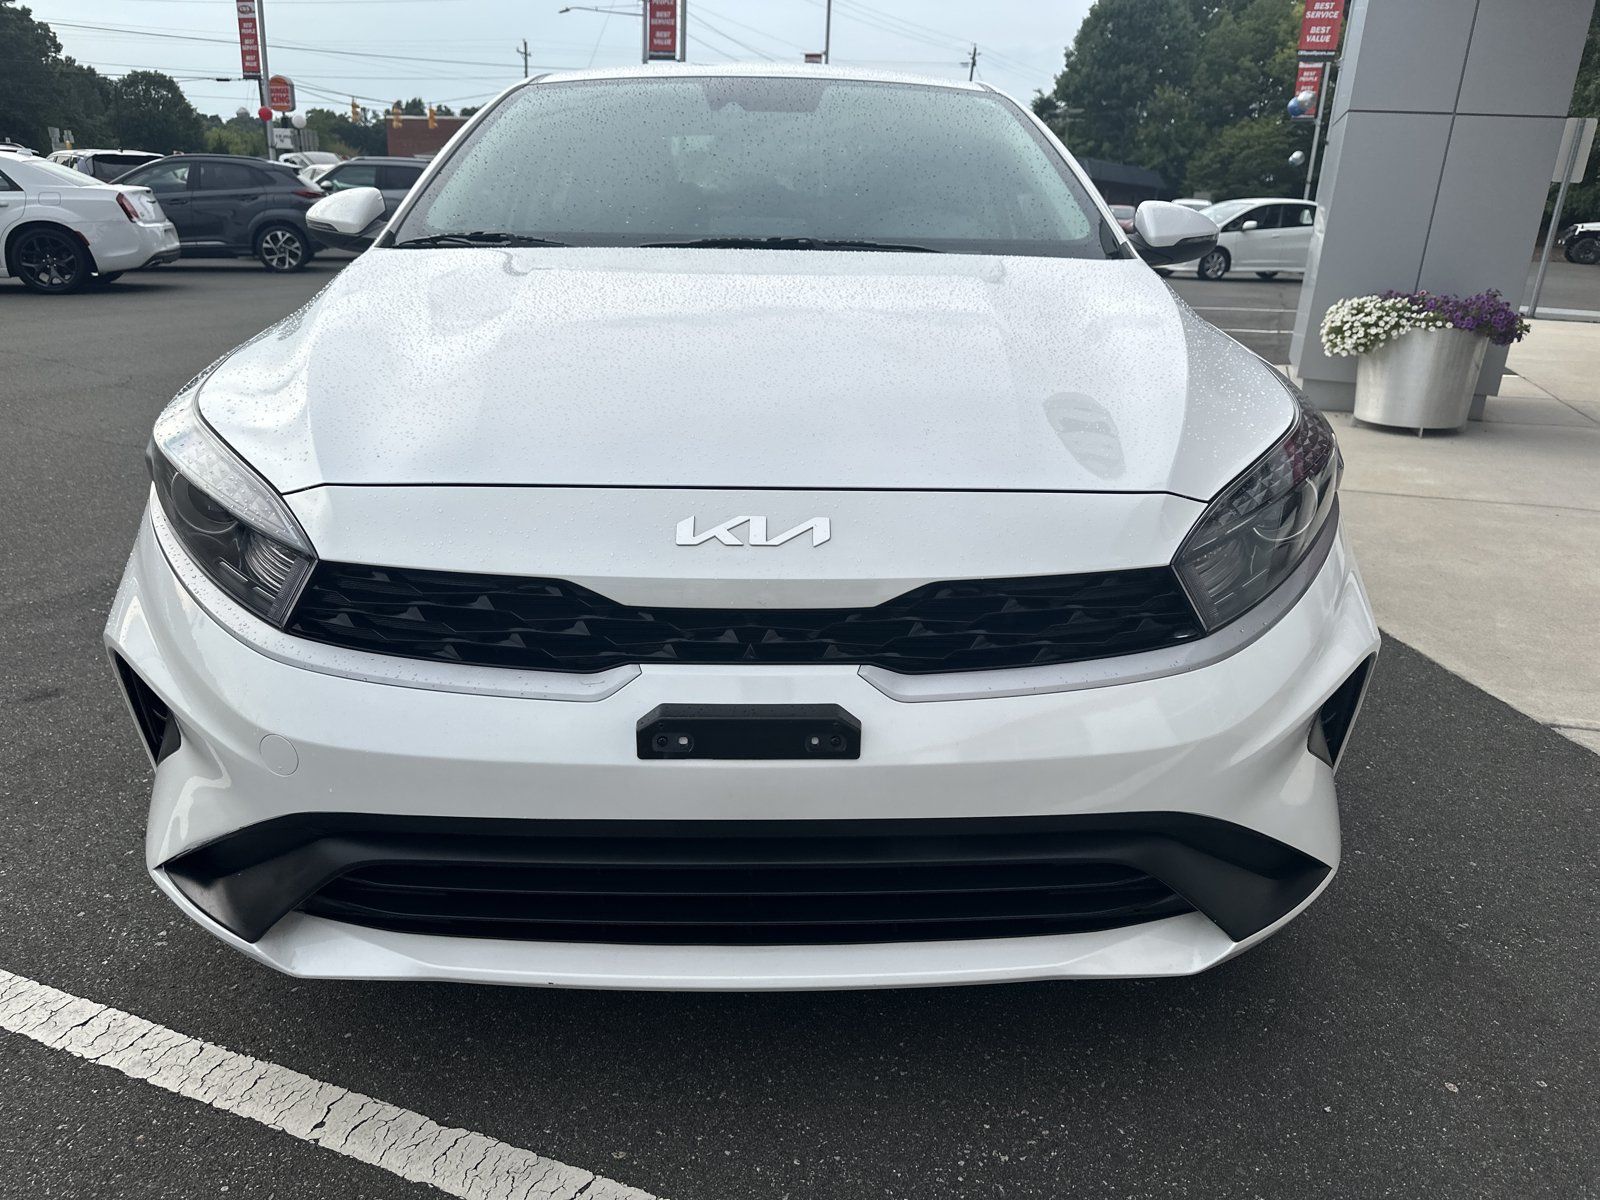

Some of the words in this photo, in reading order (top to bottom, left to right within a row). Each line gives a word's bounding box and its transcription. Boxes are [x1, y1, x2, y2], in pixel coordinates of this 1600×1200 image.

[1314, 2, 1336, 10] BEST
[1305, 10, 1340, 19] SERVICE
[1310, 26, 1332, 34] BEST
[1306, 34, 1332, 43] VALUE
[271, 95, 290, 104] KING
[676, 515, 831, 547] KIA
